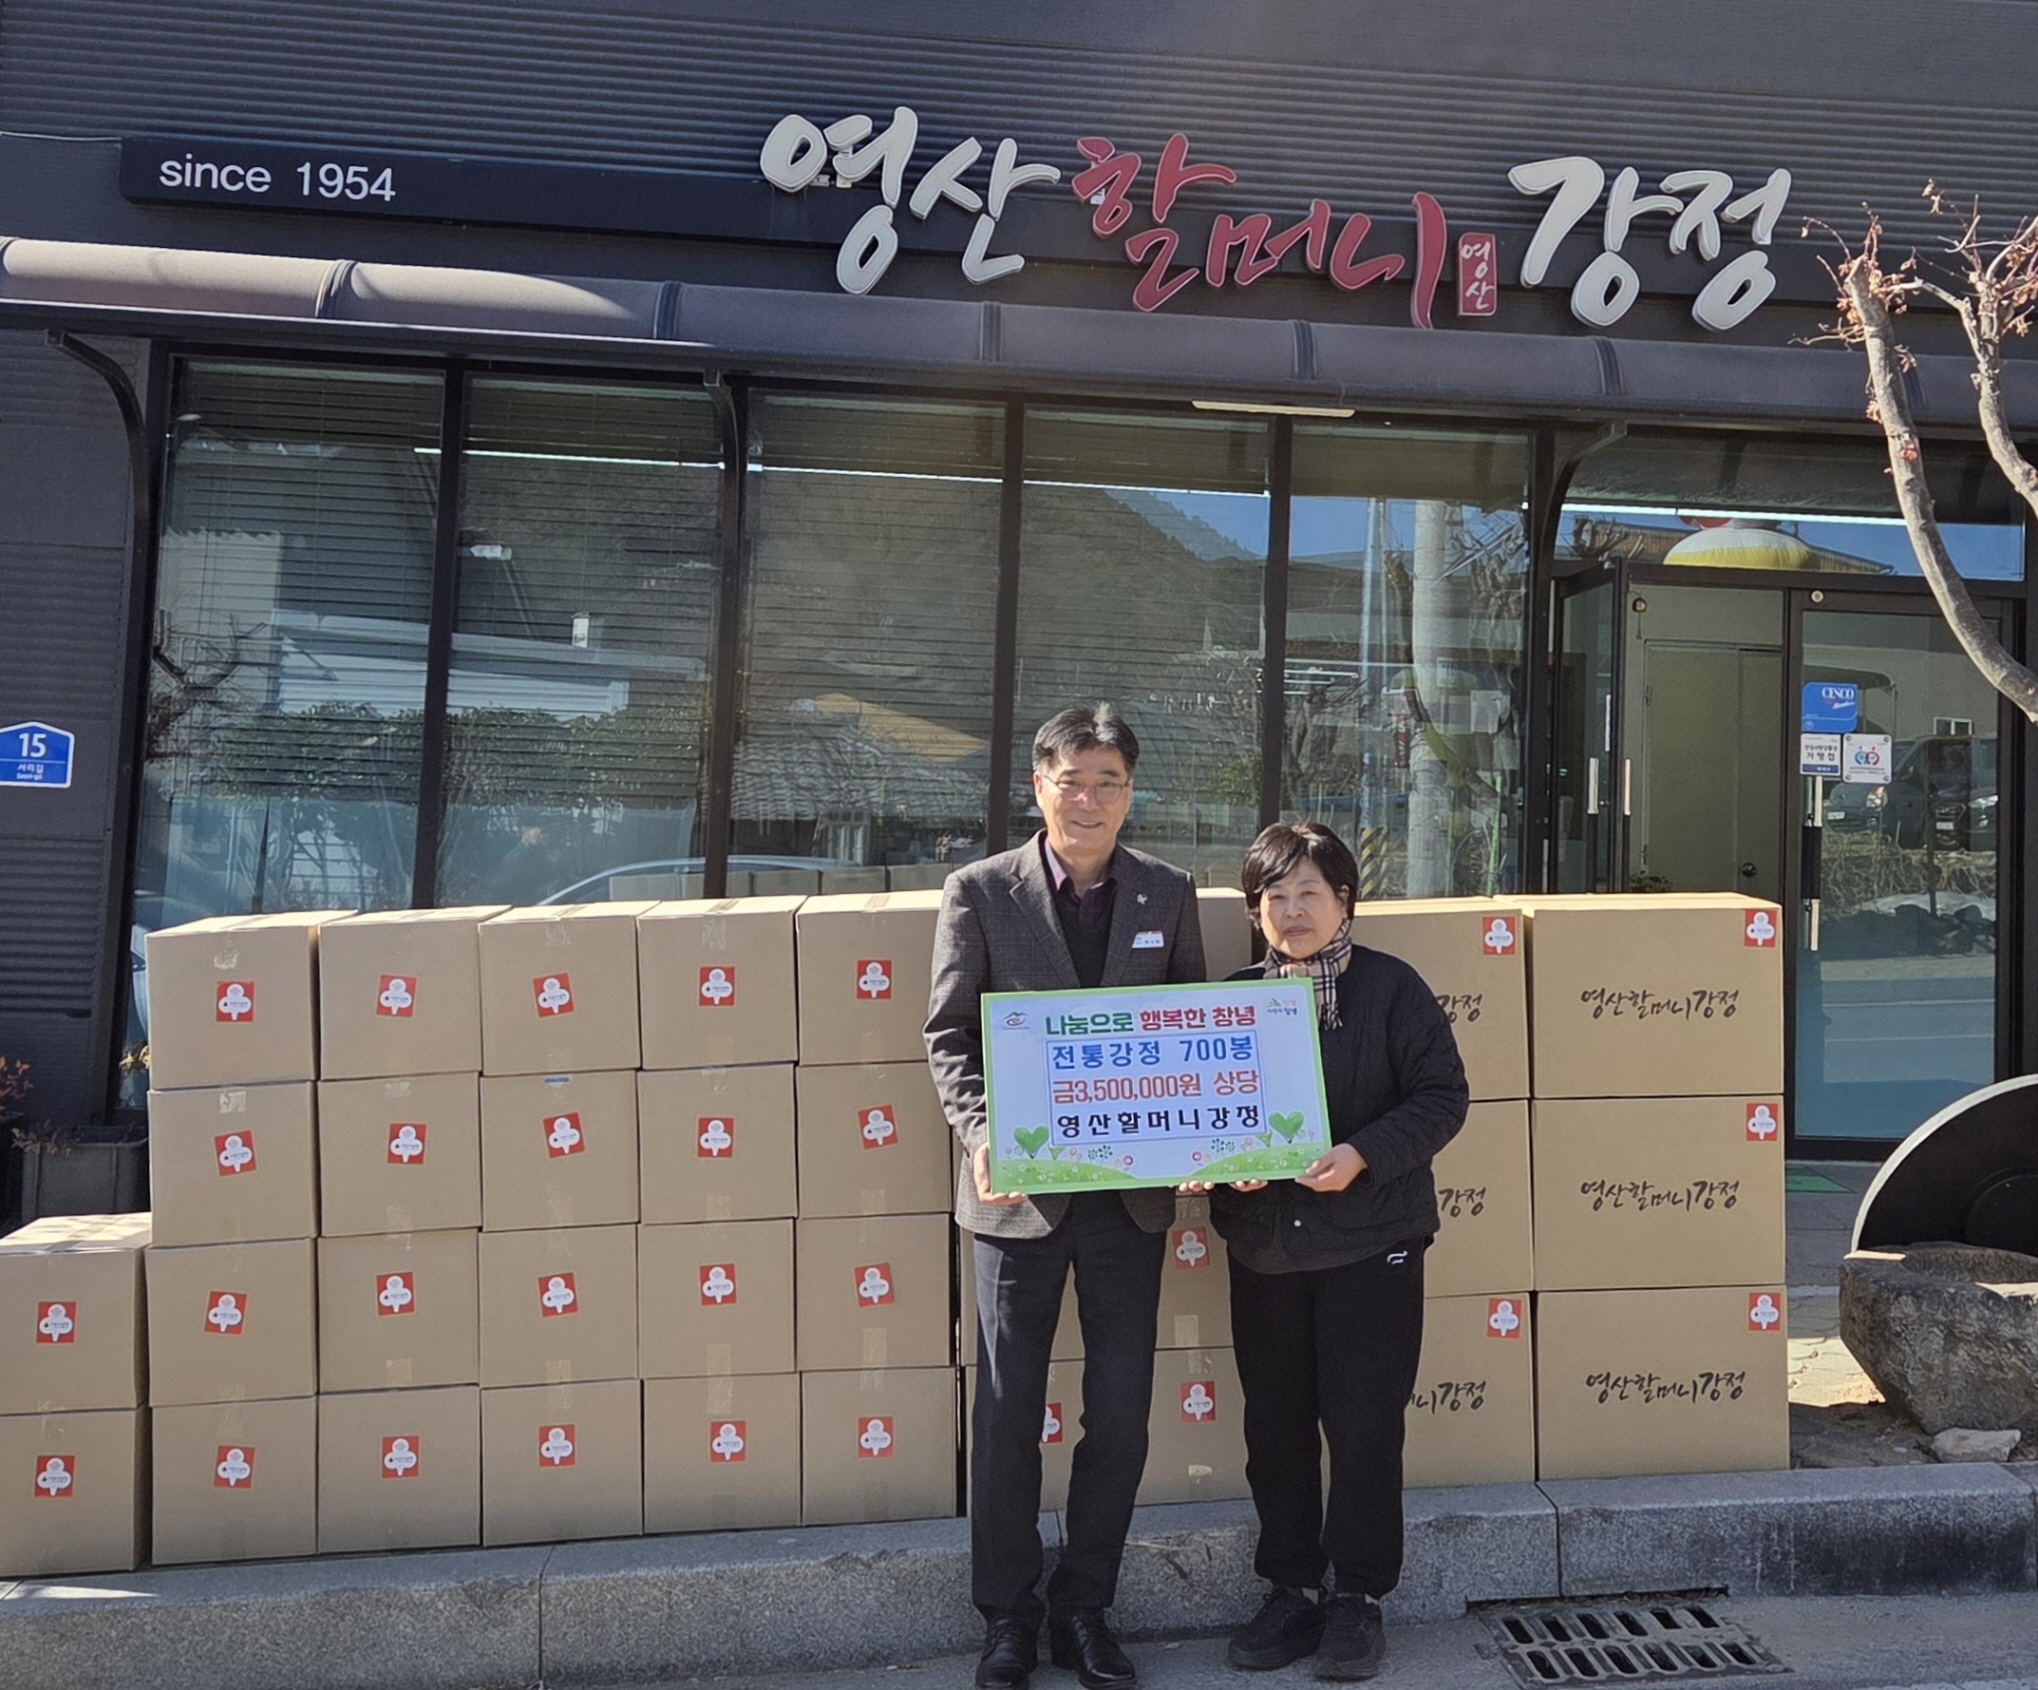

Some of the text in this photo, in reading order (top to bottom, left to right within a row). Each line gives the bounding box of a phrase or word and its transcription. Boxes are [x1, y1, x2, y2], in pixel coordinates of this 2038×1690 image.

[159, 153, 396, 201] since 1954
[760, 106, 1792, 331] 영산 할머니 강정
[1461, 241, 1491, 308] 영산
[19, 733, 46, 758] 15
[1045, 1005, 1256, 1036] 나눔으로 행복한 창녕
[1581, 987, 1739, 1021] 영산할머니강정
[1052, 1035, 1252, 1071] 전통강정 700봉
[1053, 1070, 1259, 1104] 금3,500,000원 상당
[1057, 1105, 1259, 1139] 영산할머니강정
[1580, 1180, 1740, 1212] 영산할머니강정
[1411, 1380, 1486, 1415] 니강정
[1585, 1371, 1746, 1404] 영산할머니강정
